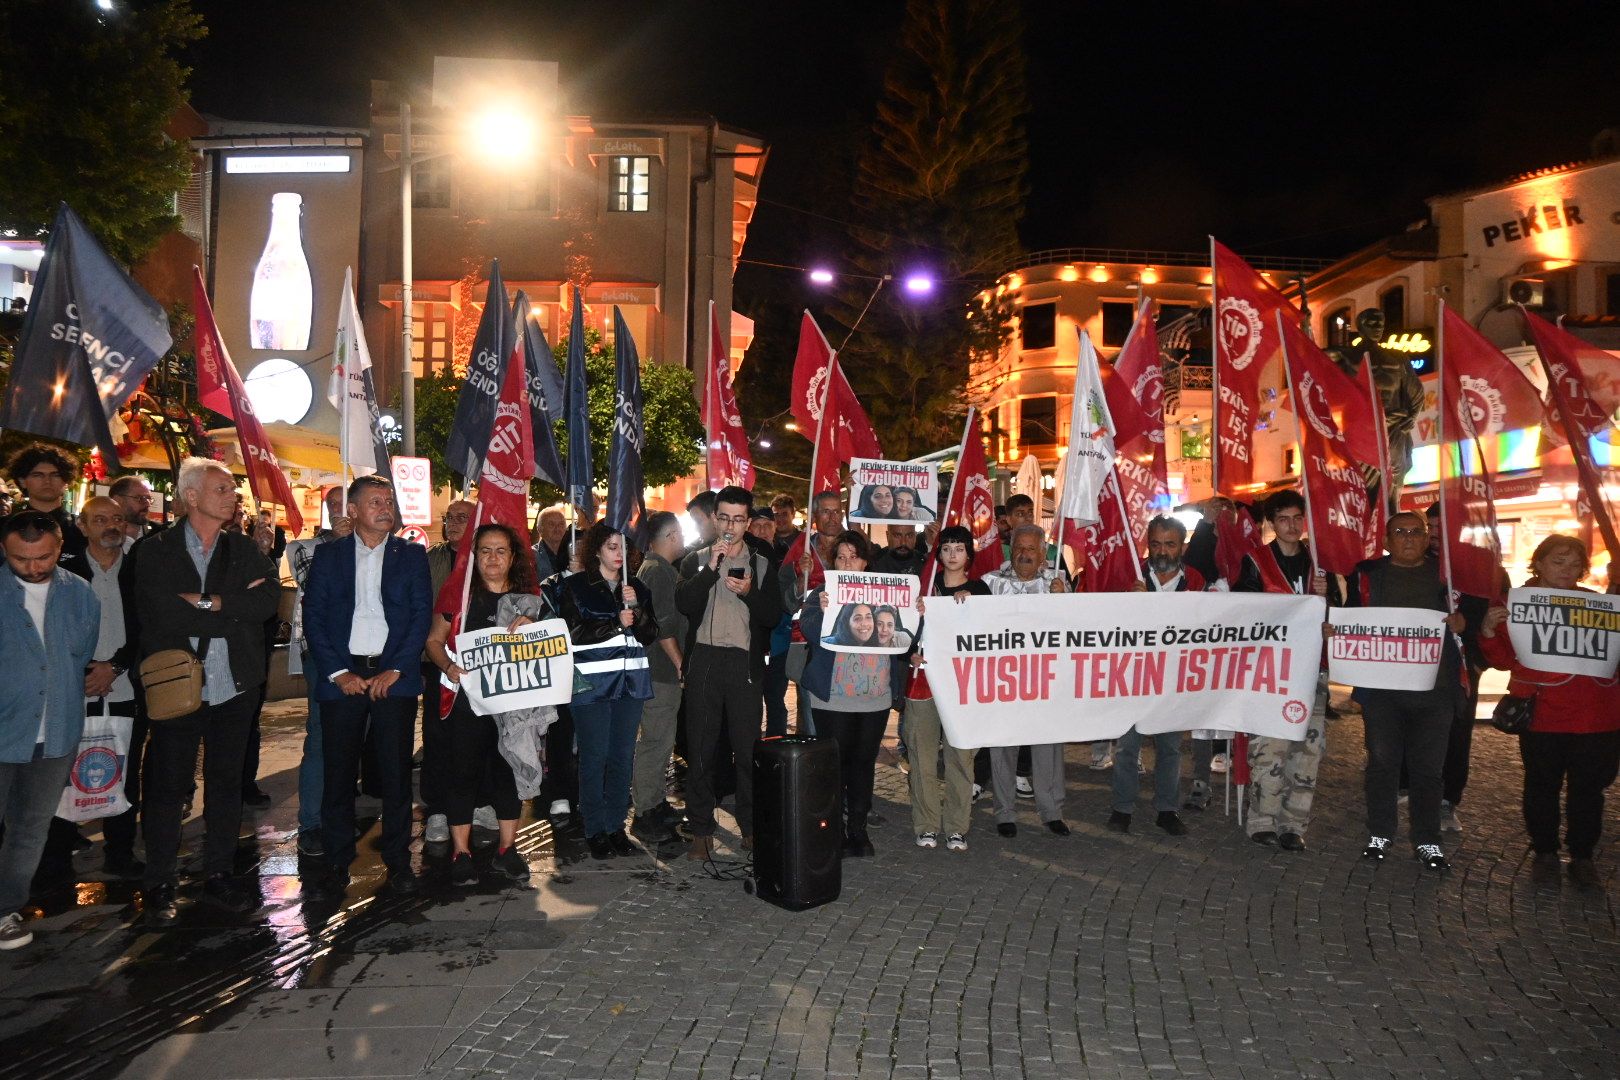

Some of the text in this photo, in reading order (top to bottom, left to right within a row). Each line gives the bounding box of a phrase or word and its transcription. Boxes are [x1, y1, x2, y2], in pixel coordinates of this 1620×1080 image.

[1483, 205, 1584, 247] PEKER
[861, 470, 928, 489] ÖZGÜRLÜK!
[889, 464, 900, 472] VE
[869, 576, 879, 585] VE
[838, 583, 910, 607] ÖZGÜRLÜK!
[1530, 594, 1549, 604] BİZE
[1586, 599, 1614, 610] YOKSA
[1513, 604, 1565, 625] SANA
[474, 635, 491, 647] BİZE
[524, 629, 549, 641] YOKSA
[956, 622, 1289, 652] NEHİR VE NEVİN'E ÖZGÜRLÜK!
[1380, 626, 1395, 637] VE
[1534, 623, 1606, 658] YOK!
[463, 636, 568, 671] SANA HUZUR
[1333, 635, 1439, 663] ÖZGÜRLÜK!
[481, 657, 549, 695] YOK!
[952, 645, 1292, 706] YUSUF TEKİN İSTİFA!
